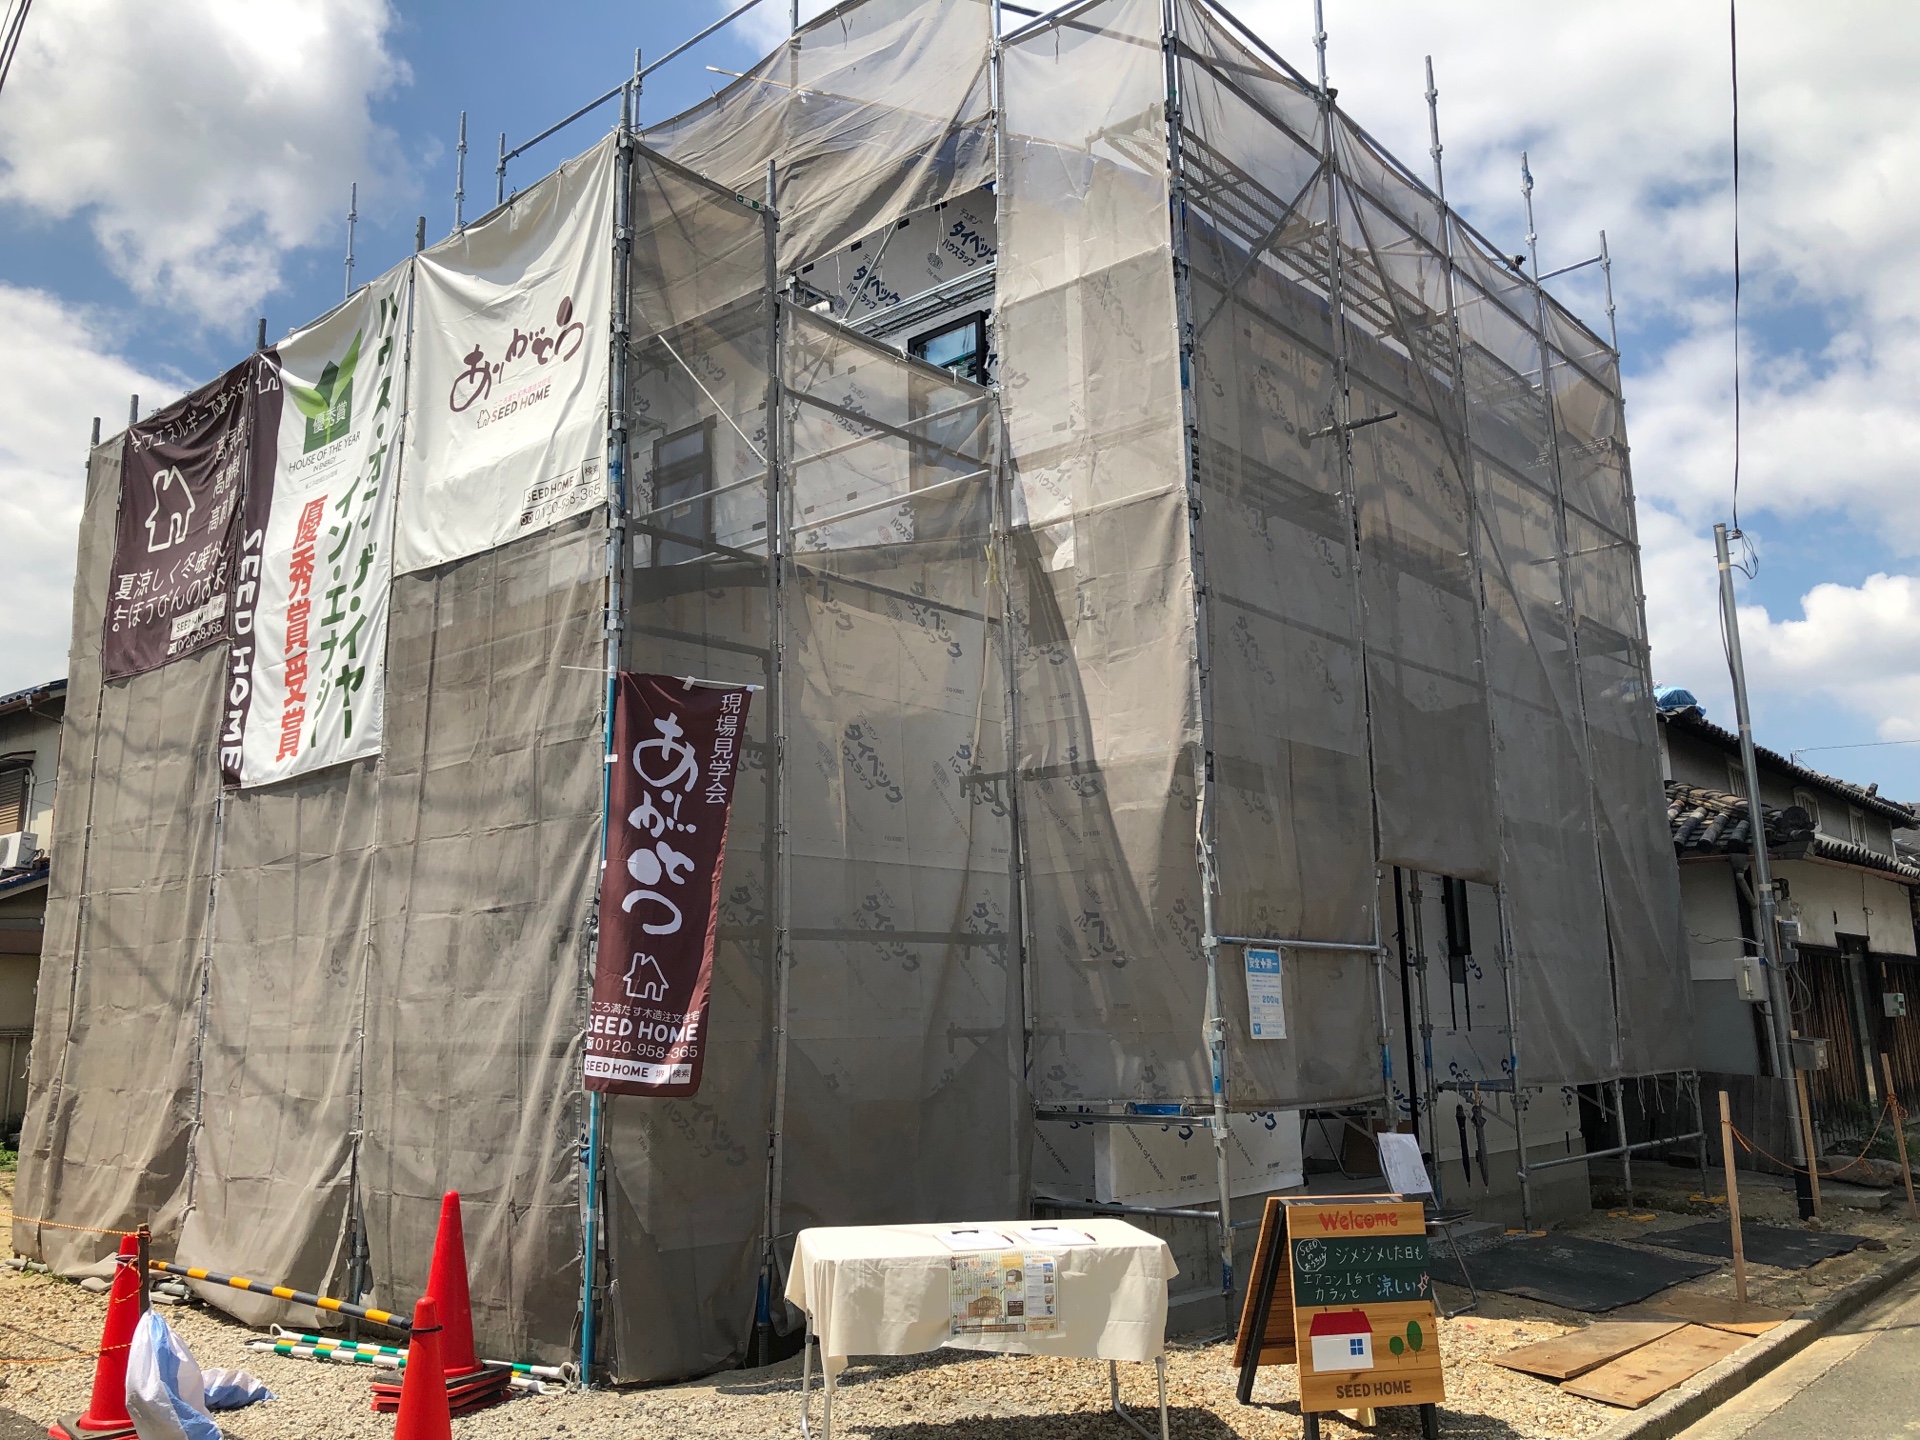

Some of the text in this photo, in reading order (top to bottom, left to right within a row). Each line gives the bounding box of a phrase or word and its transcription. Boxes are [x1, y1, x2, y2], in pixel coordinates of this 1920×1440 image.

[846, 282, 878, 310] ハウラップ
[449, 295, 584, 412] ありがとう
[312, 399, 348, 434] 優秀賞
[491, 384, 551, 423] SEED HOME
[288, 431, 361, 473] HOUSE OF THE YEAR
[526, 475, 575, 503] SEED HOME
[114, 539, 230, 600] 夏涼しく冬暖かい
[275, 494, 328, 763] 優秀賞受賞
[220, 528, 262, 772] SEED HOME
[704, 692, 743, 804] 現場見学会
[587, 1014, 699, 1044] SEED HOME
[595, 1037, 698, 1059] 0120-958-365
[586, 1060, 611, 1073] SEED
[612, 1063, 650, 1078] HOME
[1045, 1142, 1053, 1152] of
[1051, 1151, 1071, 1175] science
[1125, 1124, 1166, 1181] miracles of science
[1318, 1209, 1398, 1231] Welcome
[1299, 1240, 1318, 1257] SEED
[1335, 1244, 1424, 1265] ジメジメした日も
[1303, 1271, 1375, 1287] エアコン1台で
[1314, 1274, 1417, 1301] カラッと 涼しい
[1336, 1379, 1412, 1399] SEED HOME
